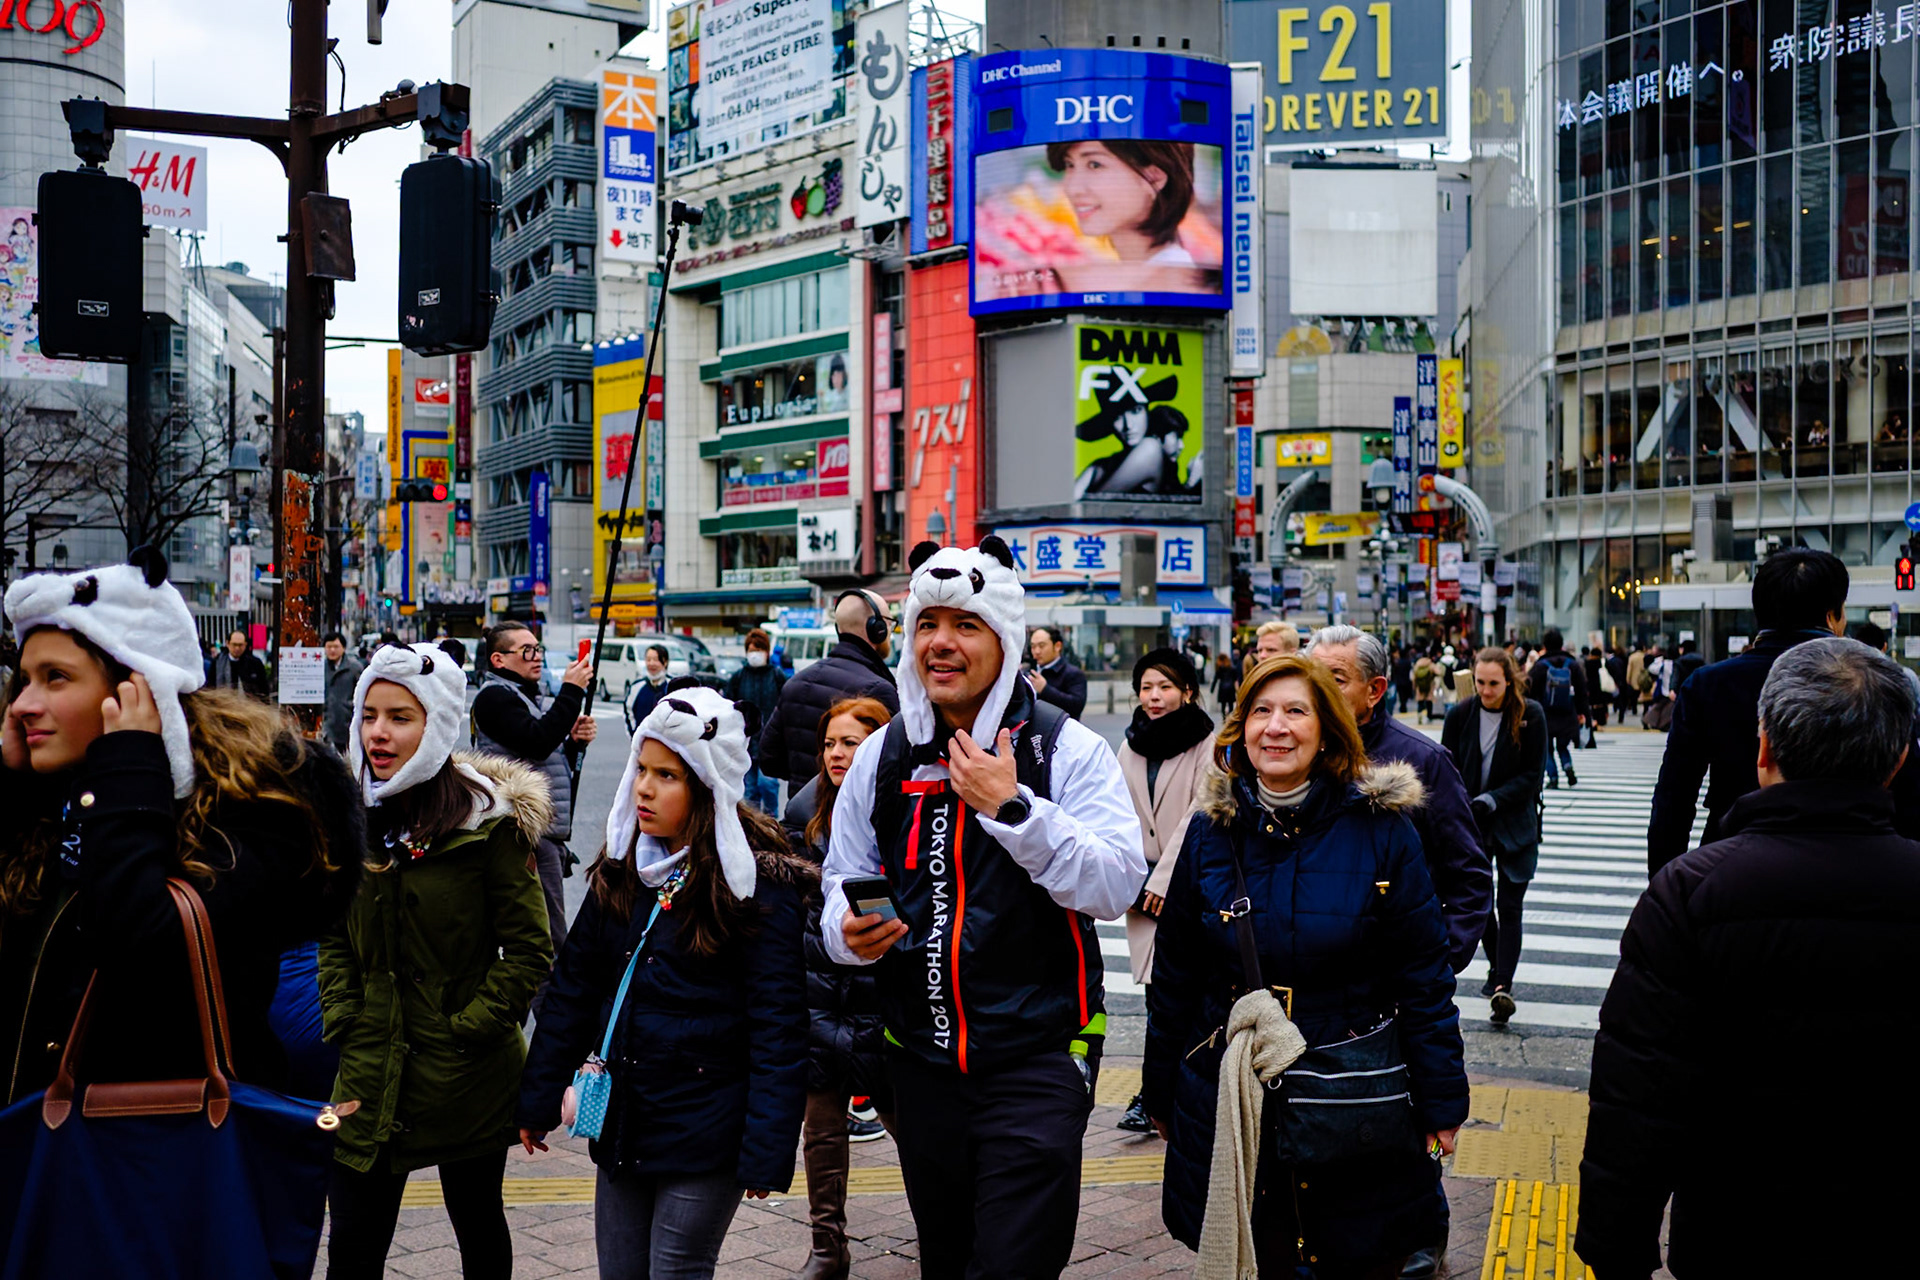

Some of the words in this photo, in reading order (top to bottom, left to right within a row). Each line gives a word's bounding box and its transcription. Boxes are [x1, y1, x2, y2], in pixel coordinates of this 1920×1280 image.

[707, 64, 739, 85] LOVE,
[742, 48, 778, 73] PEACE
[793, 32, 822, 54] FIRE
[1277, 2, 1392, 85] F21
[982, 66, 1010, 84] DHC
[1010, 60, 1061, 79] Channel
[860, 30, 905, 214] もんじゃ
[1055, 95, 1133, 125] DHC
[1264, 88, 1394, 132] OREVER
[1403, 87, 1440, 126] 21
[128, 150, 196, 198] H&M
[607, 186, 652, 206] 夜11時
[616, 207, 643, 223] まで
[627, 231, 652, 249] 地下
[1235, 213, 1251, 293] neon
[1083, 293, 1107, 304] DHC
[1080, 328, 1182, 366] DMM
[1079, 365, 1148, 403] FX
[911, 377, 971, 488] クスリ
[821, 444, 849, 472] JTB
[1011, 535, 1193, 572] 大盛堂店
[929, 804, 949, 876] TOKYO
[927, 881, 949, 1000] MARATHON
[930, 1006, 950, 1050] 2017
